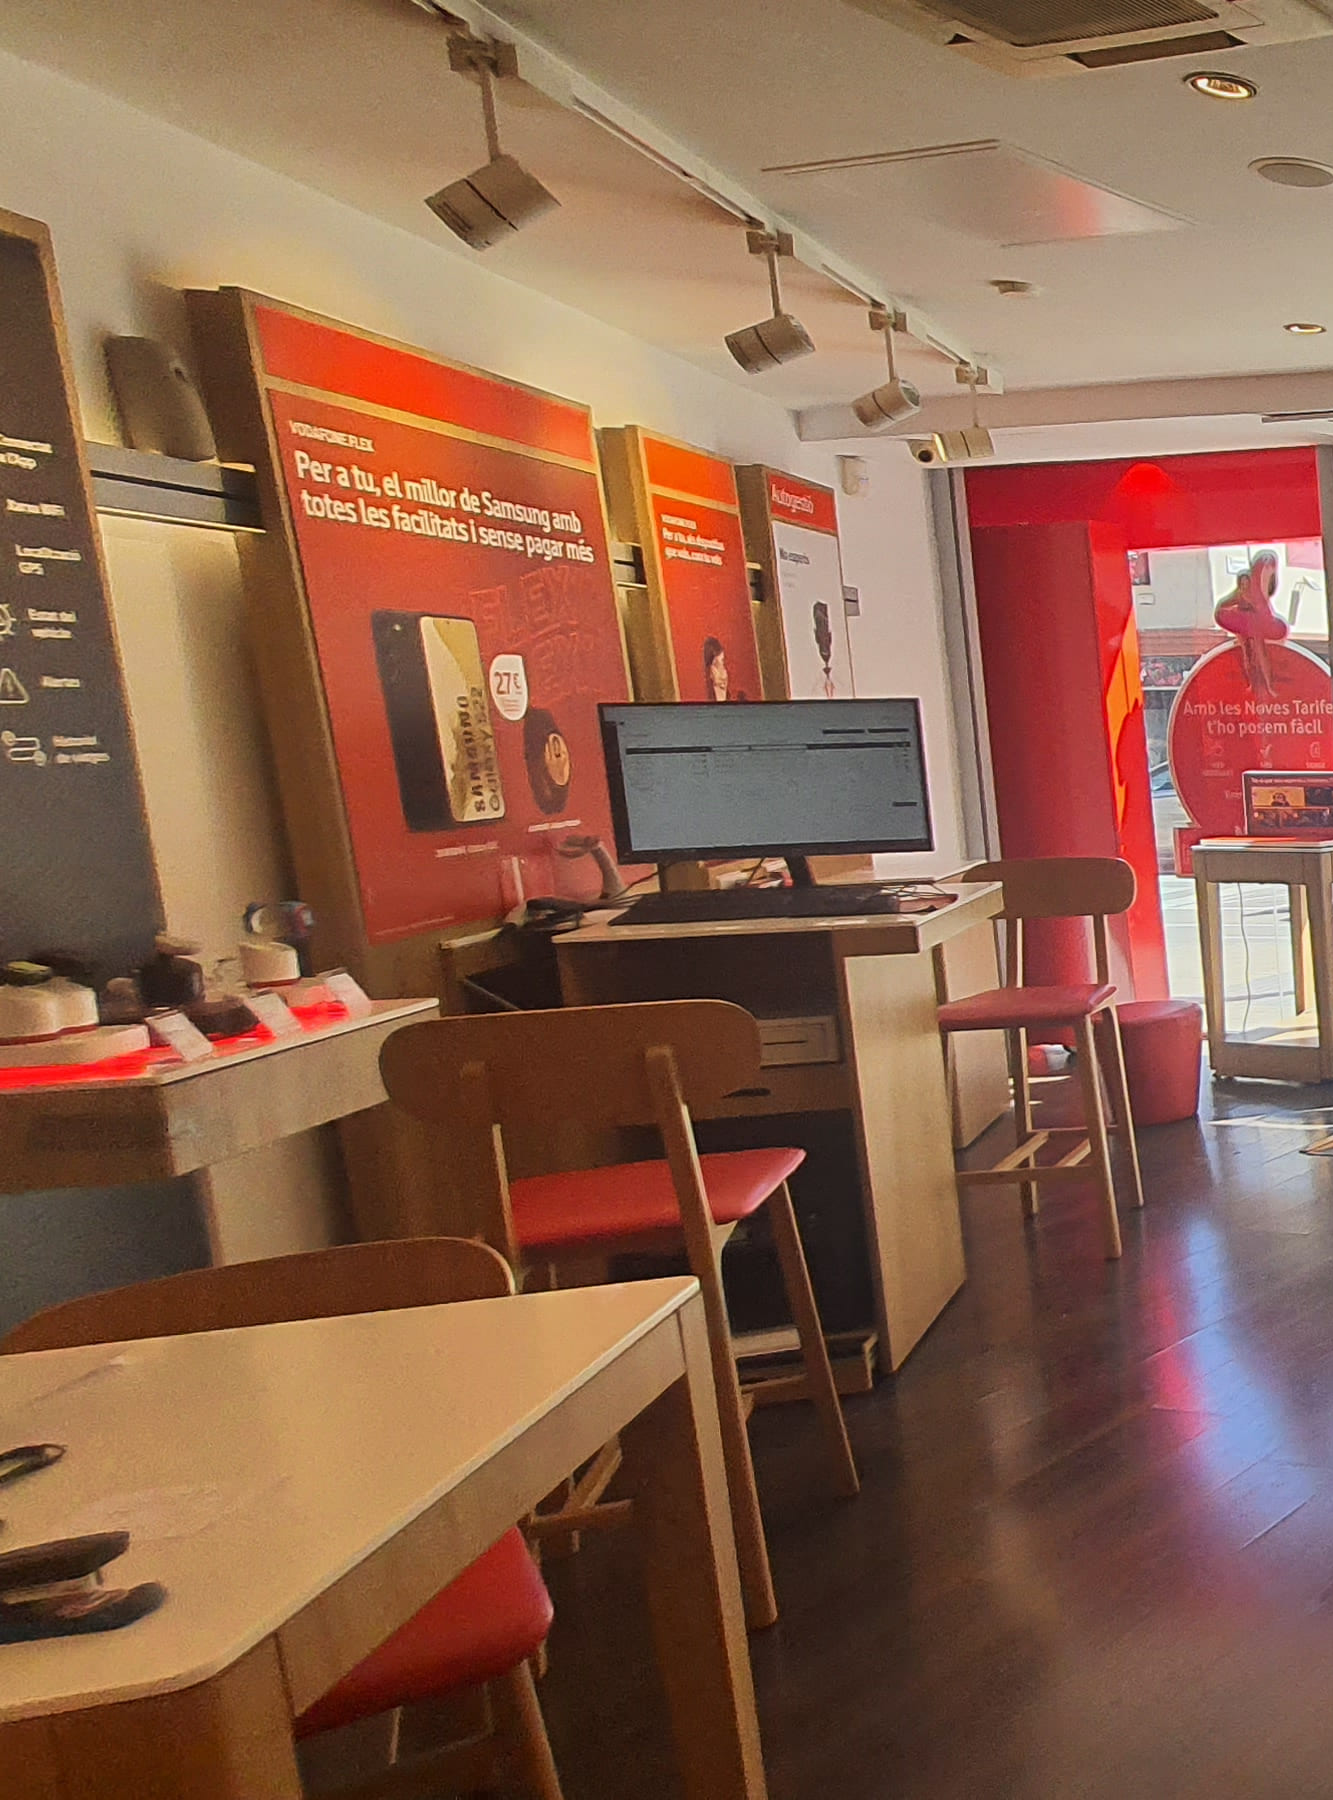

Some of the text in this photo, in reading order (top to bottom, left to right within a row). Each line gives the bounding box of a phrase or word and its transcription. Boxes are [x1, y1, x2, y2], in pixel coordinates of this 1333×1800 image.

[294, 450, 582, 533] Per a tu, el millor de Samsung amb
[301, 489, 595, 563] totes les facilitats i sense pagar més
[1183, 702, 1217, 715] Amb
[1220, 701, 1241, 715] les
[1245, 701, 1290, 715] Noves
[1207, 718, 1323, 738] t'ho posem fàcil
